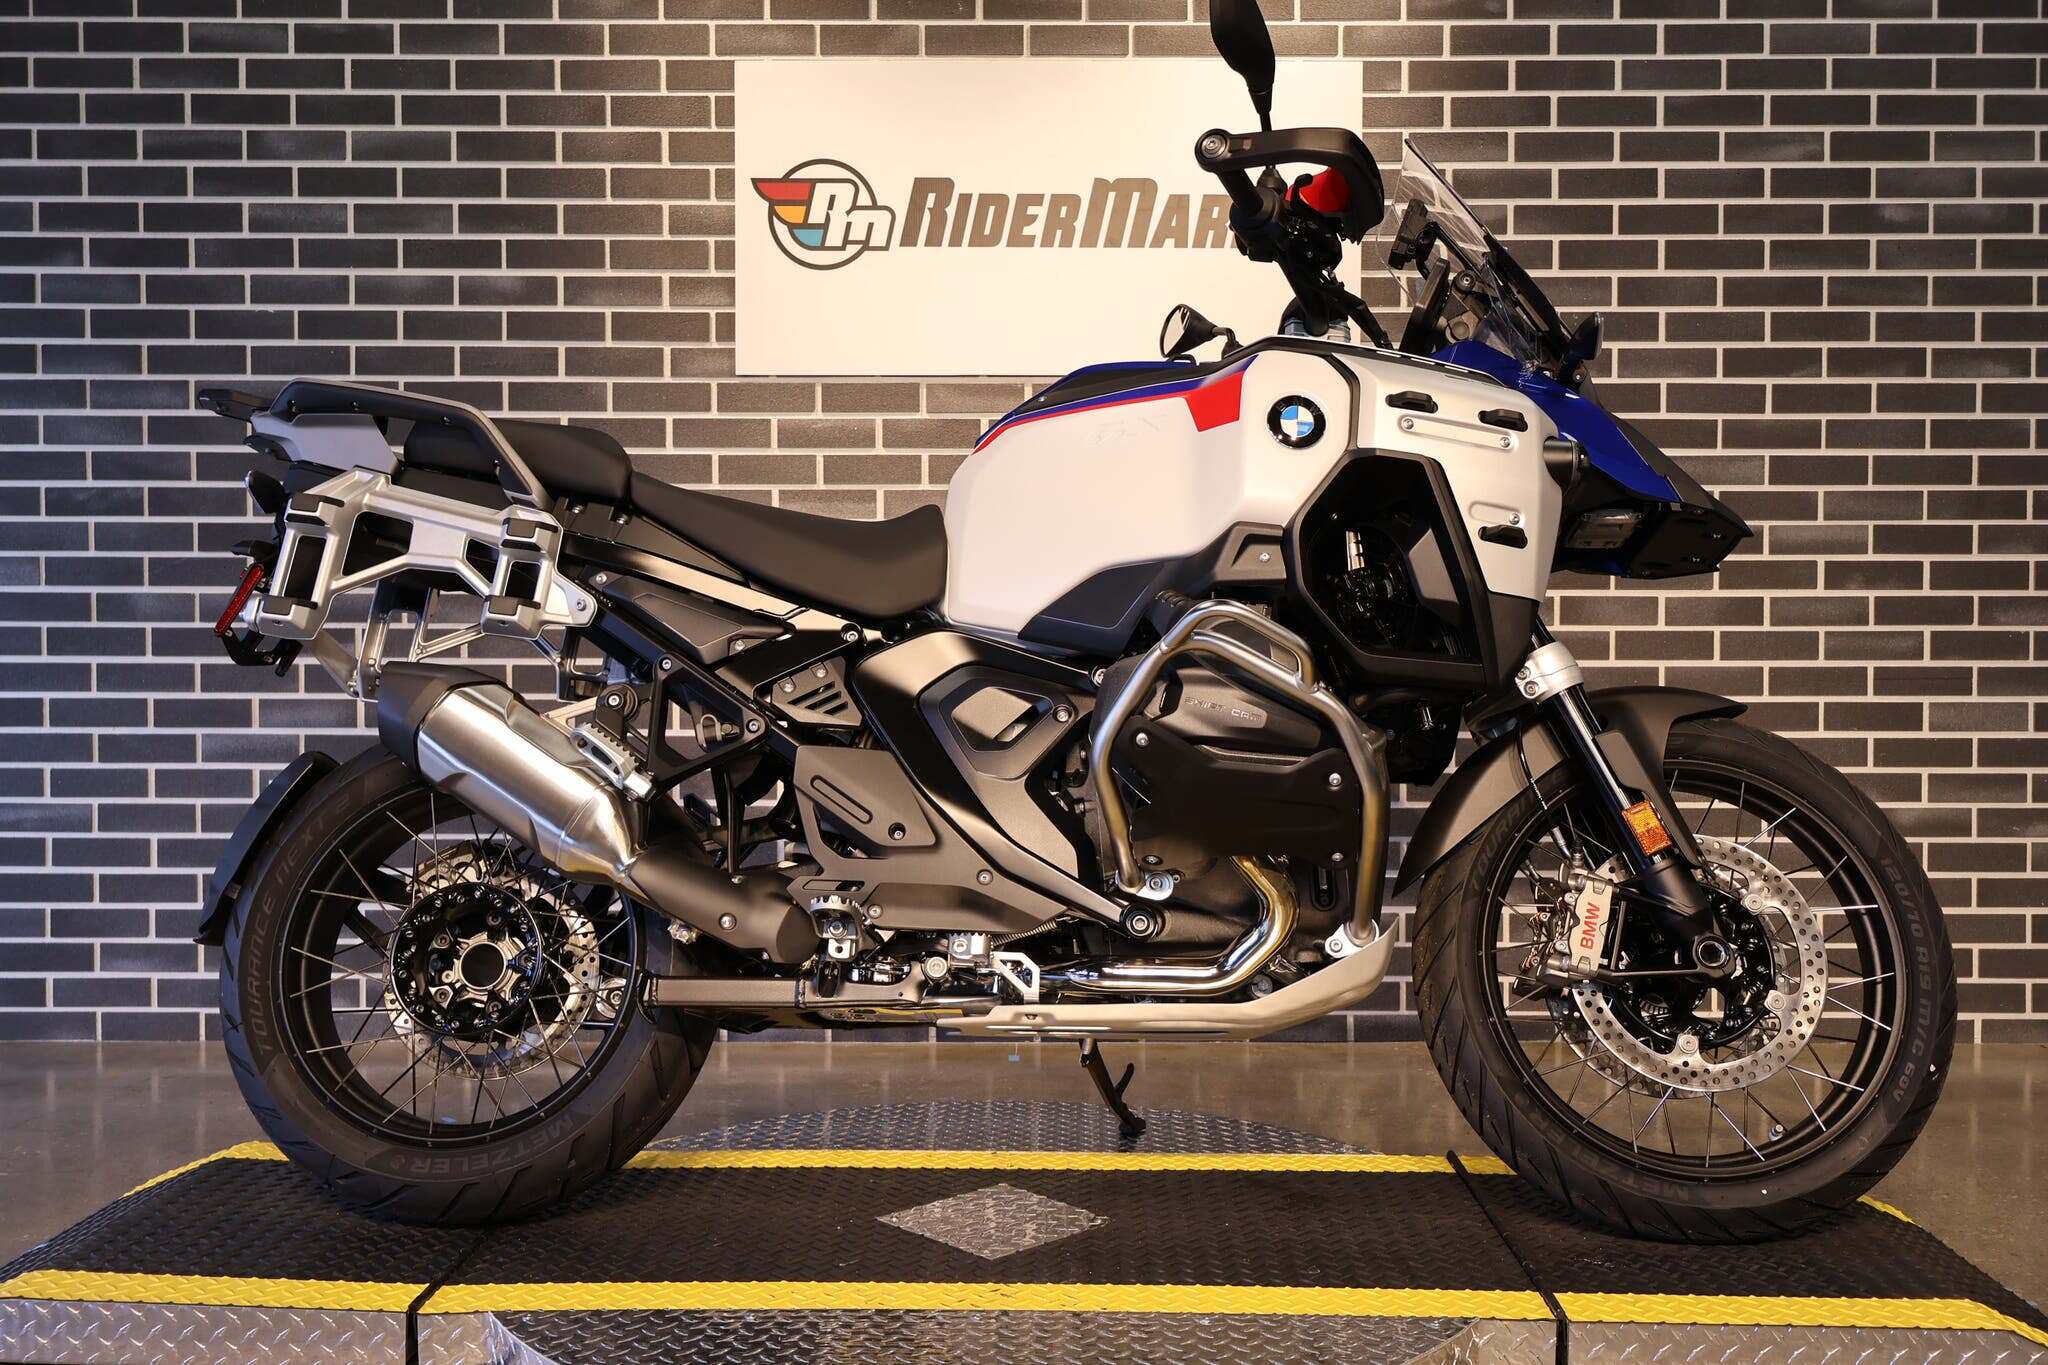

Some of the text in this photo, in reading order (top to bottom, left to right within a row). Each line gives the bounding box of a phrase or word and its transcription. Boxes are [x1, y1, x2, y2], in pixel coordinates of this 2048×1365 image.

[899, 176, 1237, 249] RIDERMAR
[1579, 901, 1602, 950] BMW
[410, 1114, 575, 1174] METZELER
